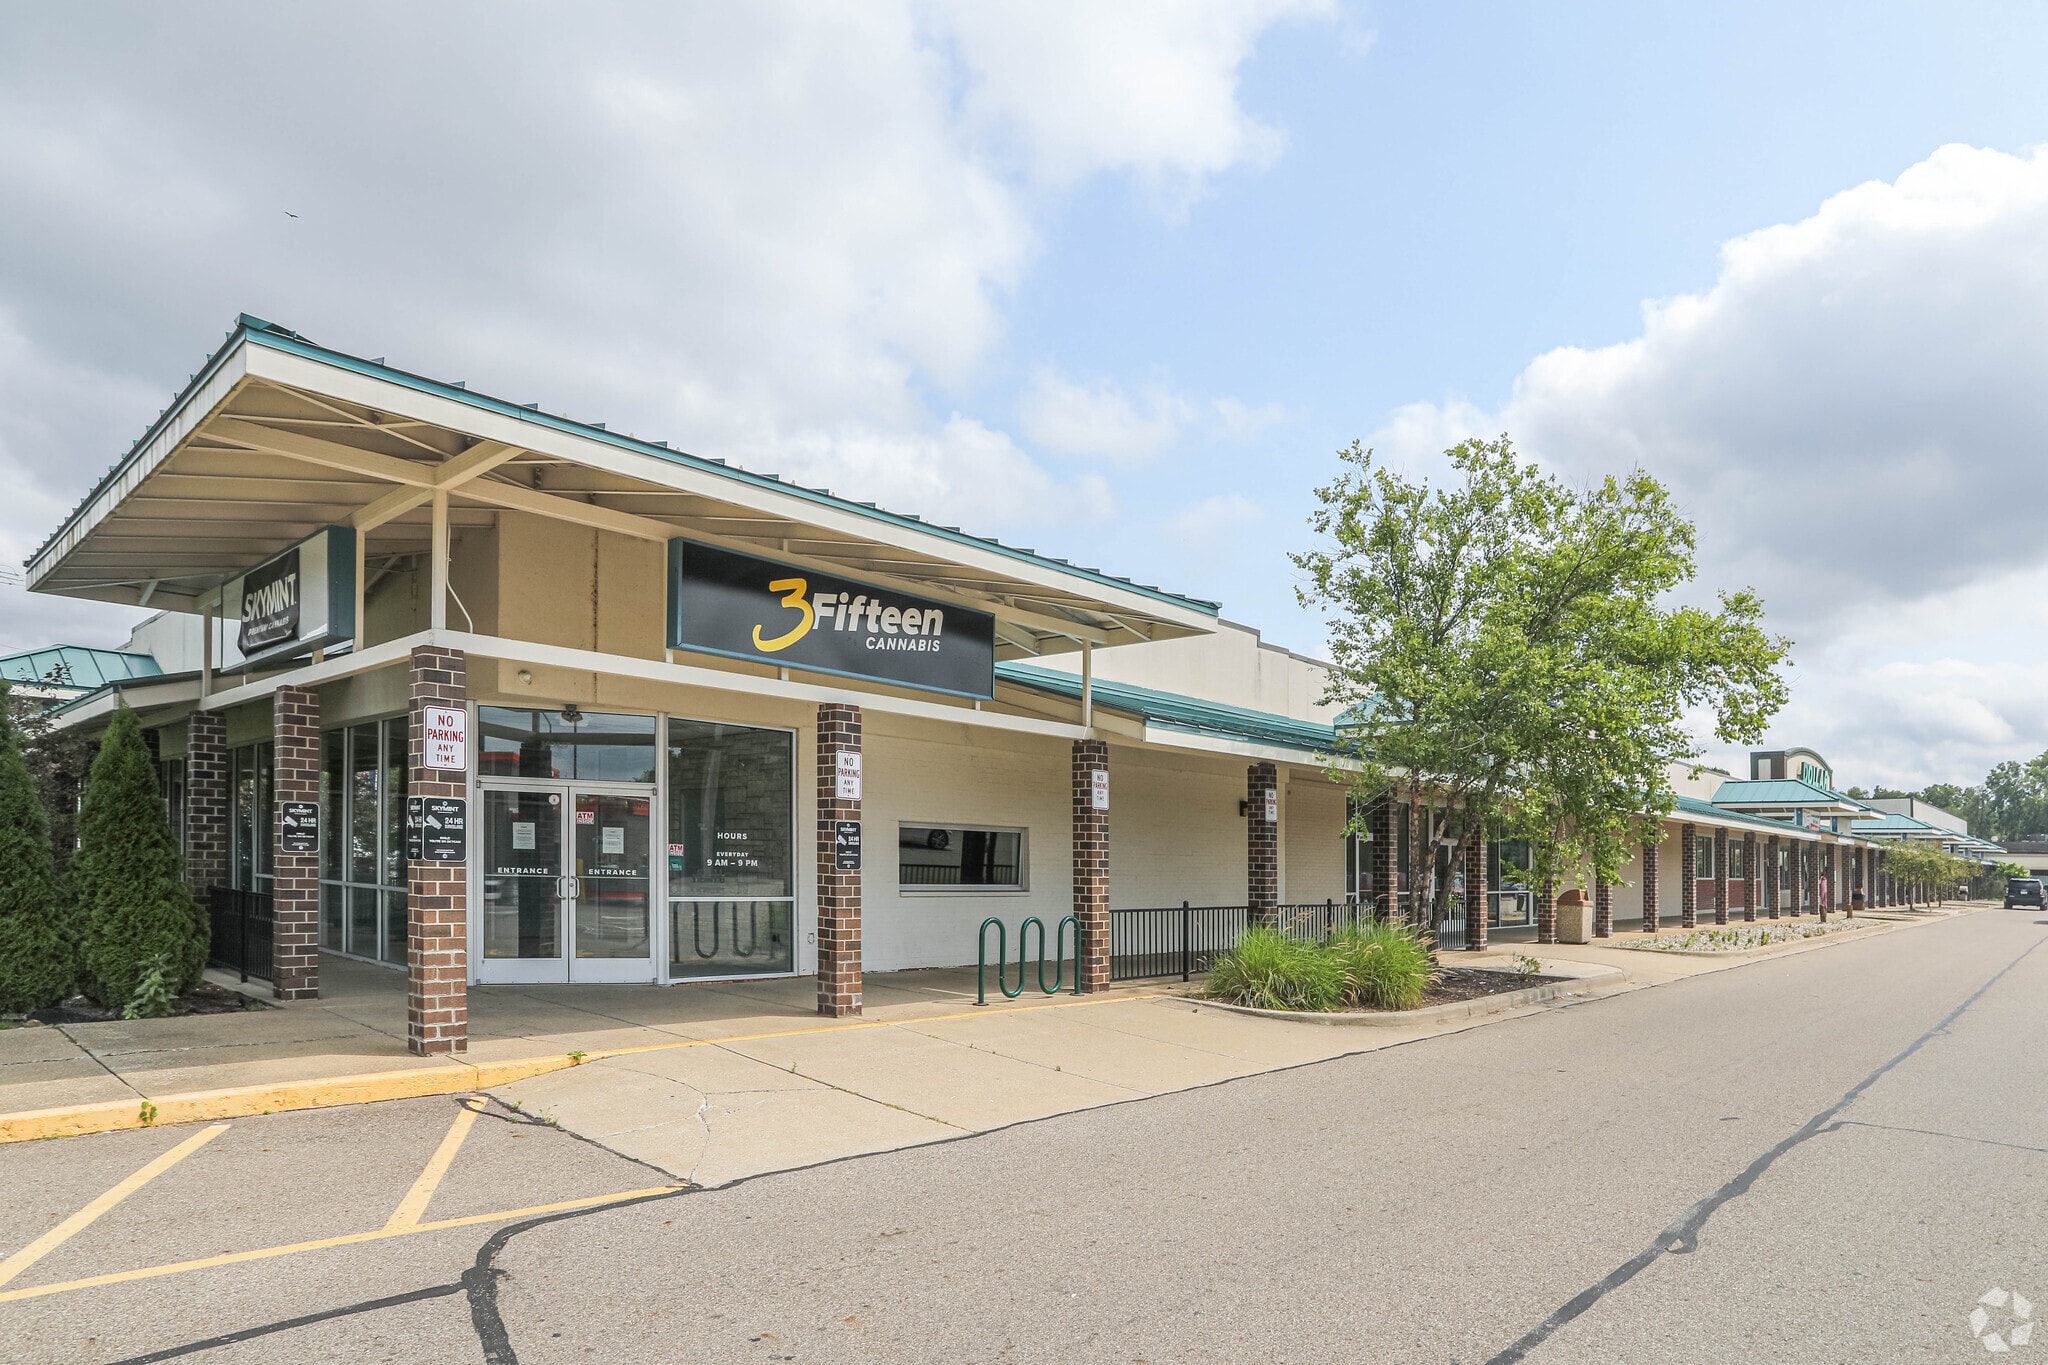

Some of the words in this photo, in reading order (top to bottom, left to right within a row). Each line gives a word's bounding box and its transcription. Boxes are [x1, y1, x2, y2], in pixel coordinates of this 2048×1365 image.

[865, 636, 941, 652] CANNABIS
[437, 715, 454, 727] NO
[427, 728, 464, 743] PARKING
[437, 744, 454, 752] ANY
[436, 754, 456, 763] TIME
[843, 757, 854, 767] NO
[837, 767, 860, 778] PARKING
[1801, 761, 1830, 791] DOLLAR
[1093, 781, 1108, 790] PARKING
[454, 817, 464, 825] HR
[717, 832, 748, 840] HOURS
[706, 859, 713, 867] 9
[714, 859, 728, 867] AM
[737, 859, 743, 867] 9
[588, 868, 637, 876] ENTRANCE
